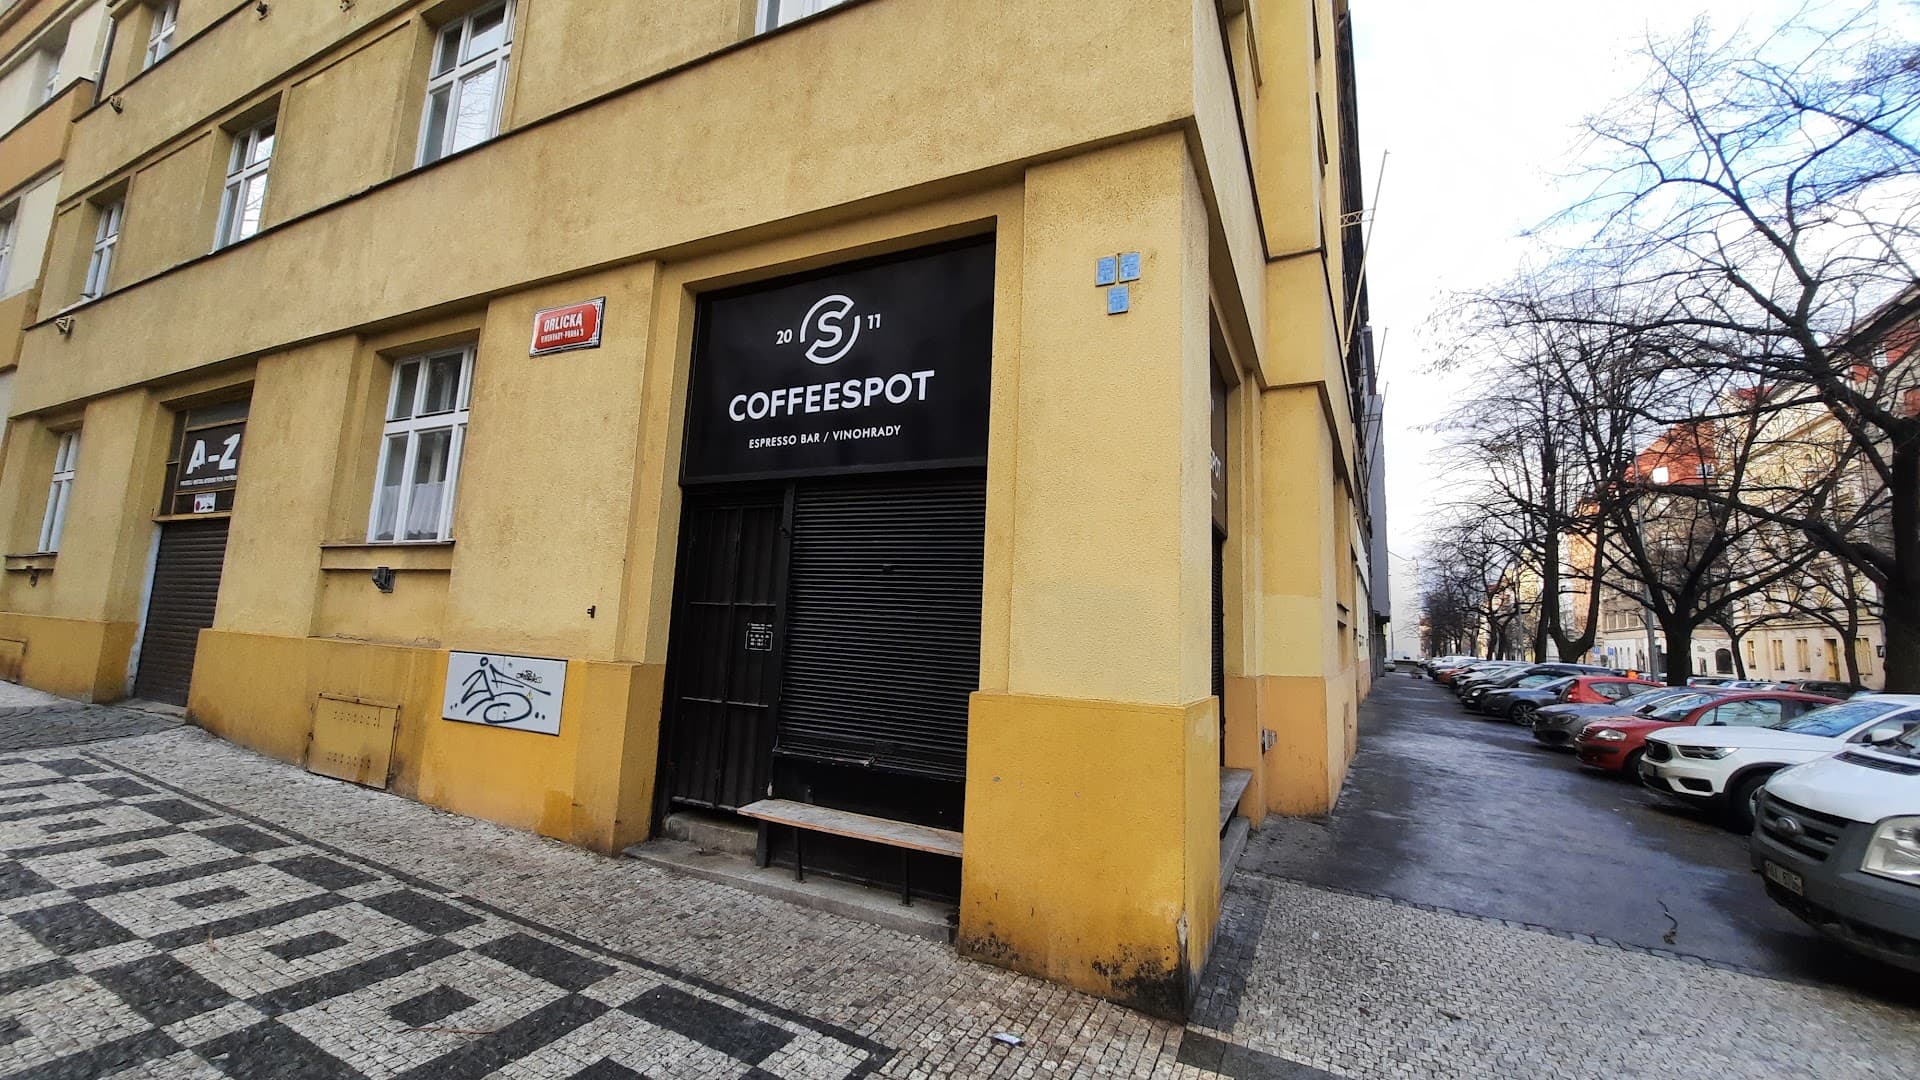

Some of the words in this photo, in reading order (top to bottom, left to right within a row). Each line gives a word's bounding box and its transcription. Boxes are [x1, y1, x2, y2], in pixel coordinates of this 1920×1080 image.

[775, 328, 793, 345] 20
[867, 313, 881, 330] 11
[728, 369, 935, 422] COFFEESPOT
[186, 433, 241, 475] A-Z
[748, 434, 797, 449] ESPRESSO
[800, 432, 820, 444] BAR
[832, 424, 902, 441] VINOHRADY
